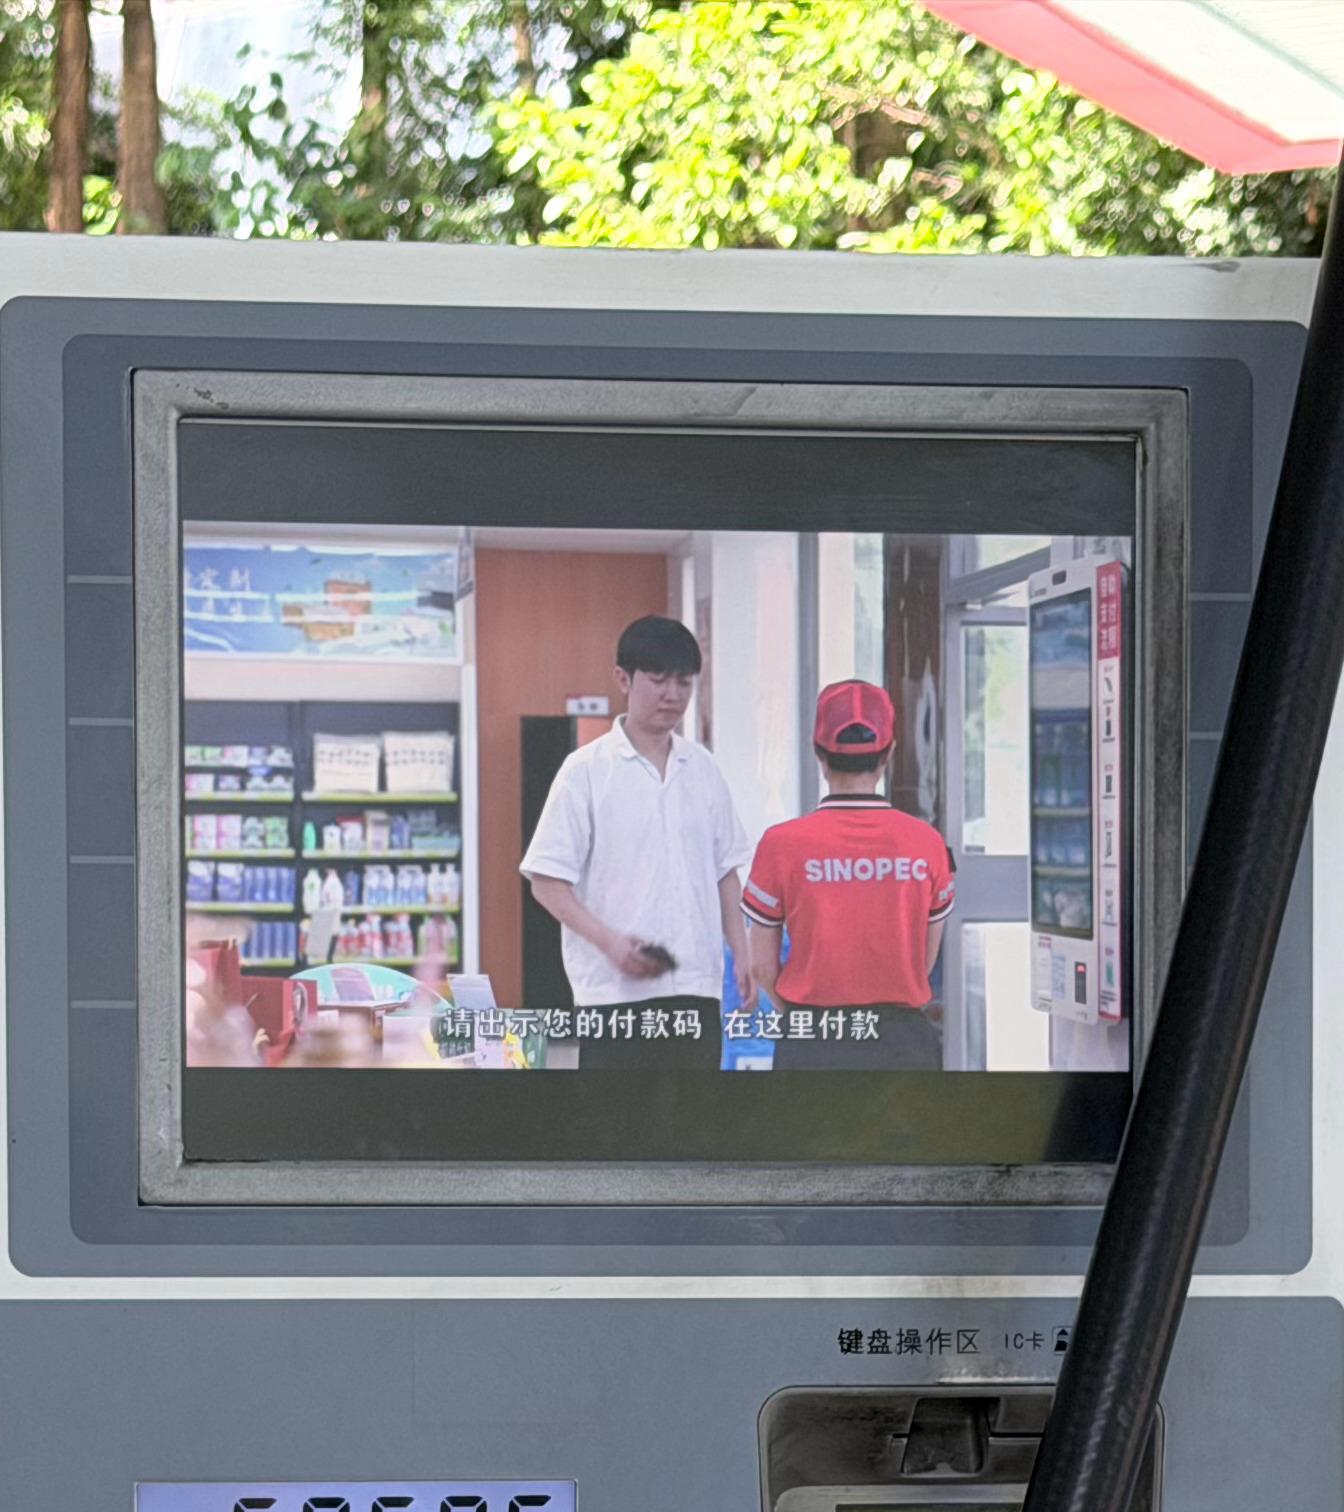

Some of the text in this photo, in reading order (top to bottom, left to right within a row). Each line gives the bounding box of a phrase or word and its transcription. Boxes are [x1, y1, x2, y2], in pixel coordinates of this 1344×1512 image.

[805, 857, 929, 882] SINOPEC
[444, 1009, 880, 1041] 请出示您的付款码 在这里付款
[837, 1328, 1045, 1355] 键盘操作区 IC卡
